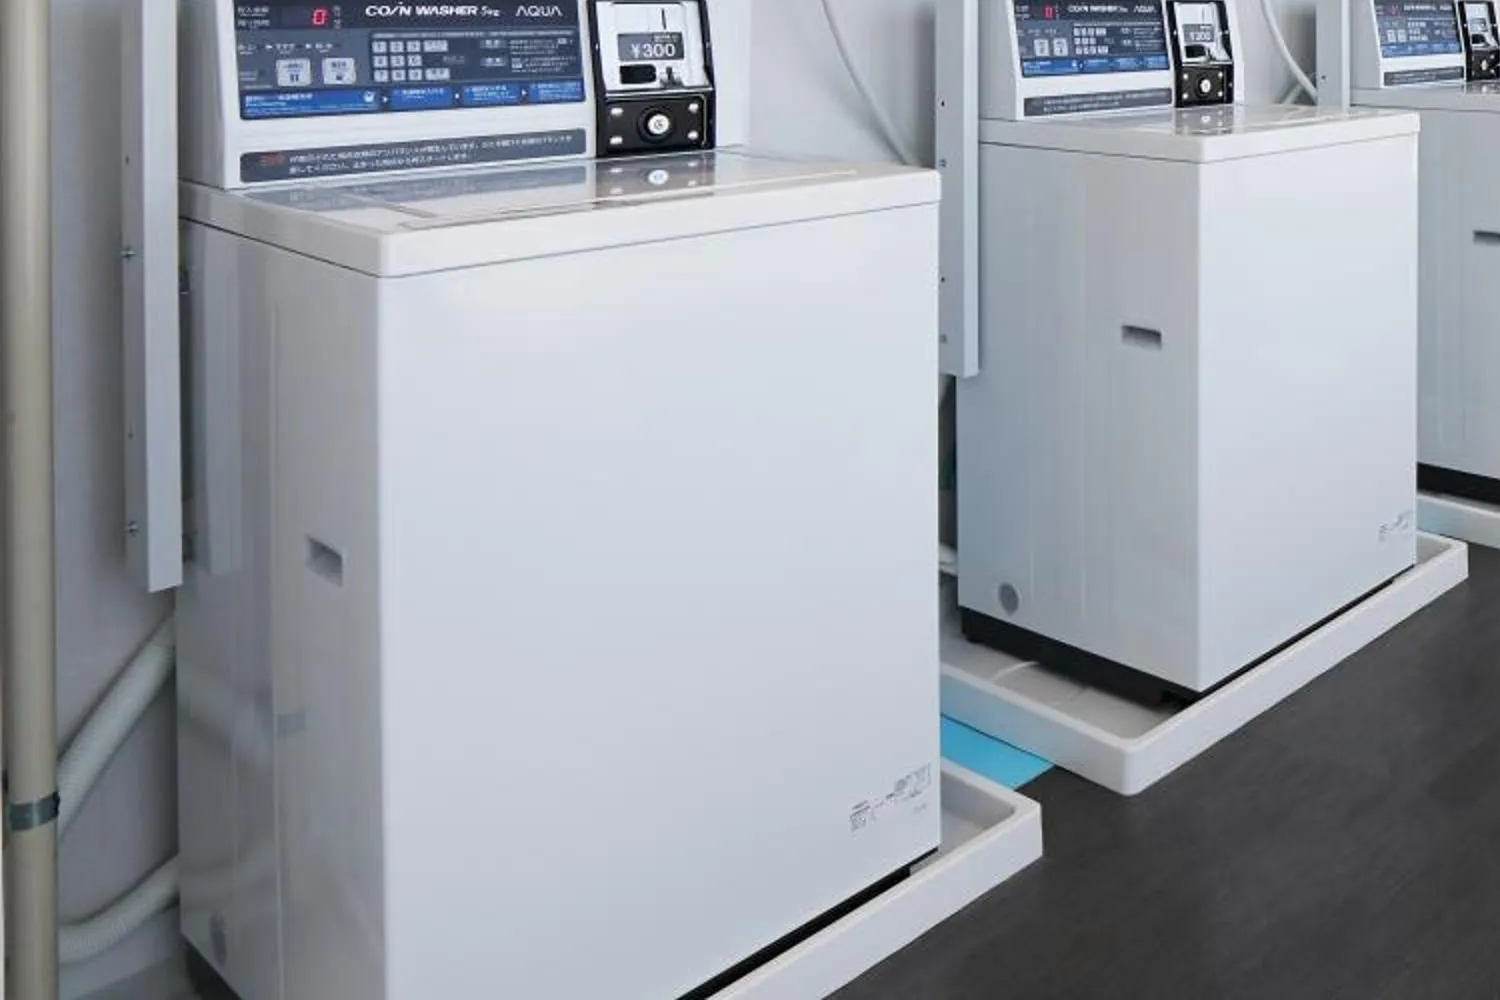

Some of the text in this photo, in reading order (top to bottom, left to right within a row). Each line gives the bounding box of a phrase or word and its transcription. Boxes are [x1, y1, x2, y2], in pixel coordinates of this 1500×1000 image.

[313, 8, 326, 25] 0
[415, 5, 478, 16] WASHER
[515, 6, 563, 17] AQUA
[631, 42, 676, 59] ¥300
